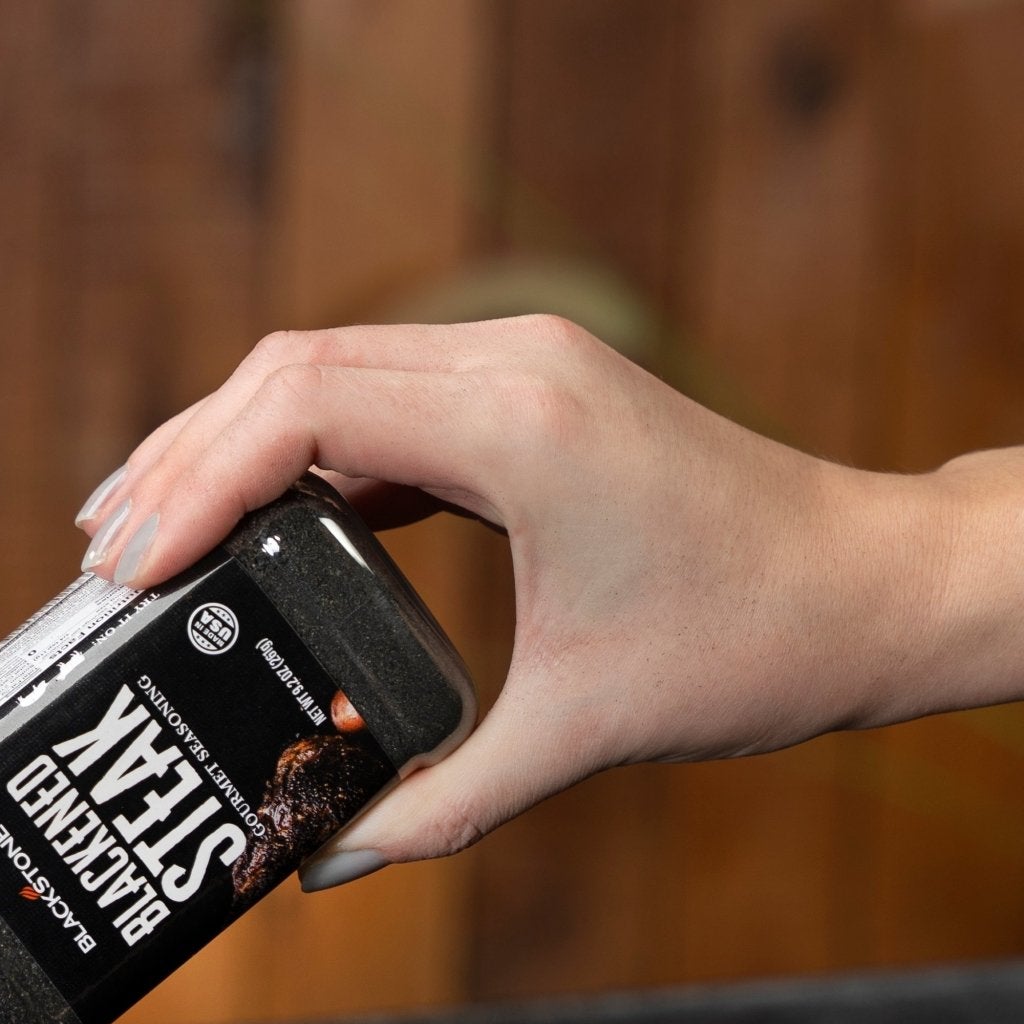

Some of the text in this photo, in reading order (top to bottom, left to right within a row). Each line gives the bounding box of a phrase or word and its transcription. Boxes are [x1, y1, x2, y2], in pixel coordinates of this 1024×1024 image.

[115, 611, 133, 628] IT
[132, 590, 161, 614] TRY
[201, 611, 231, 641] USA
[203, 628, 224, 647] MADE
[256, 638, 326, 726] NET WT 9.2 OZ (261g)
[137, 675, 264, 837] GOURMET SEASONING
[52, 684, 248, 902] STEAK
[7, 755, 170, 946] BLACKENED
